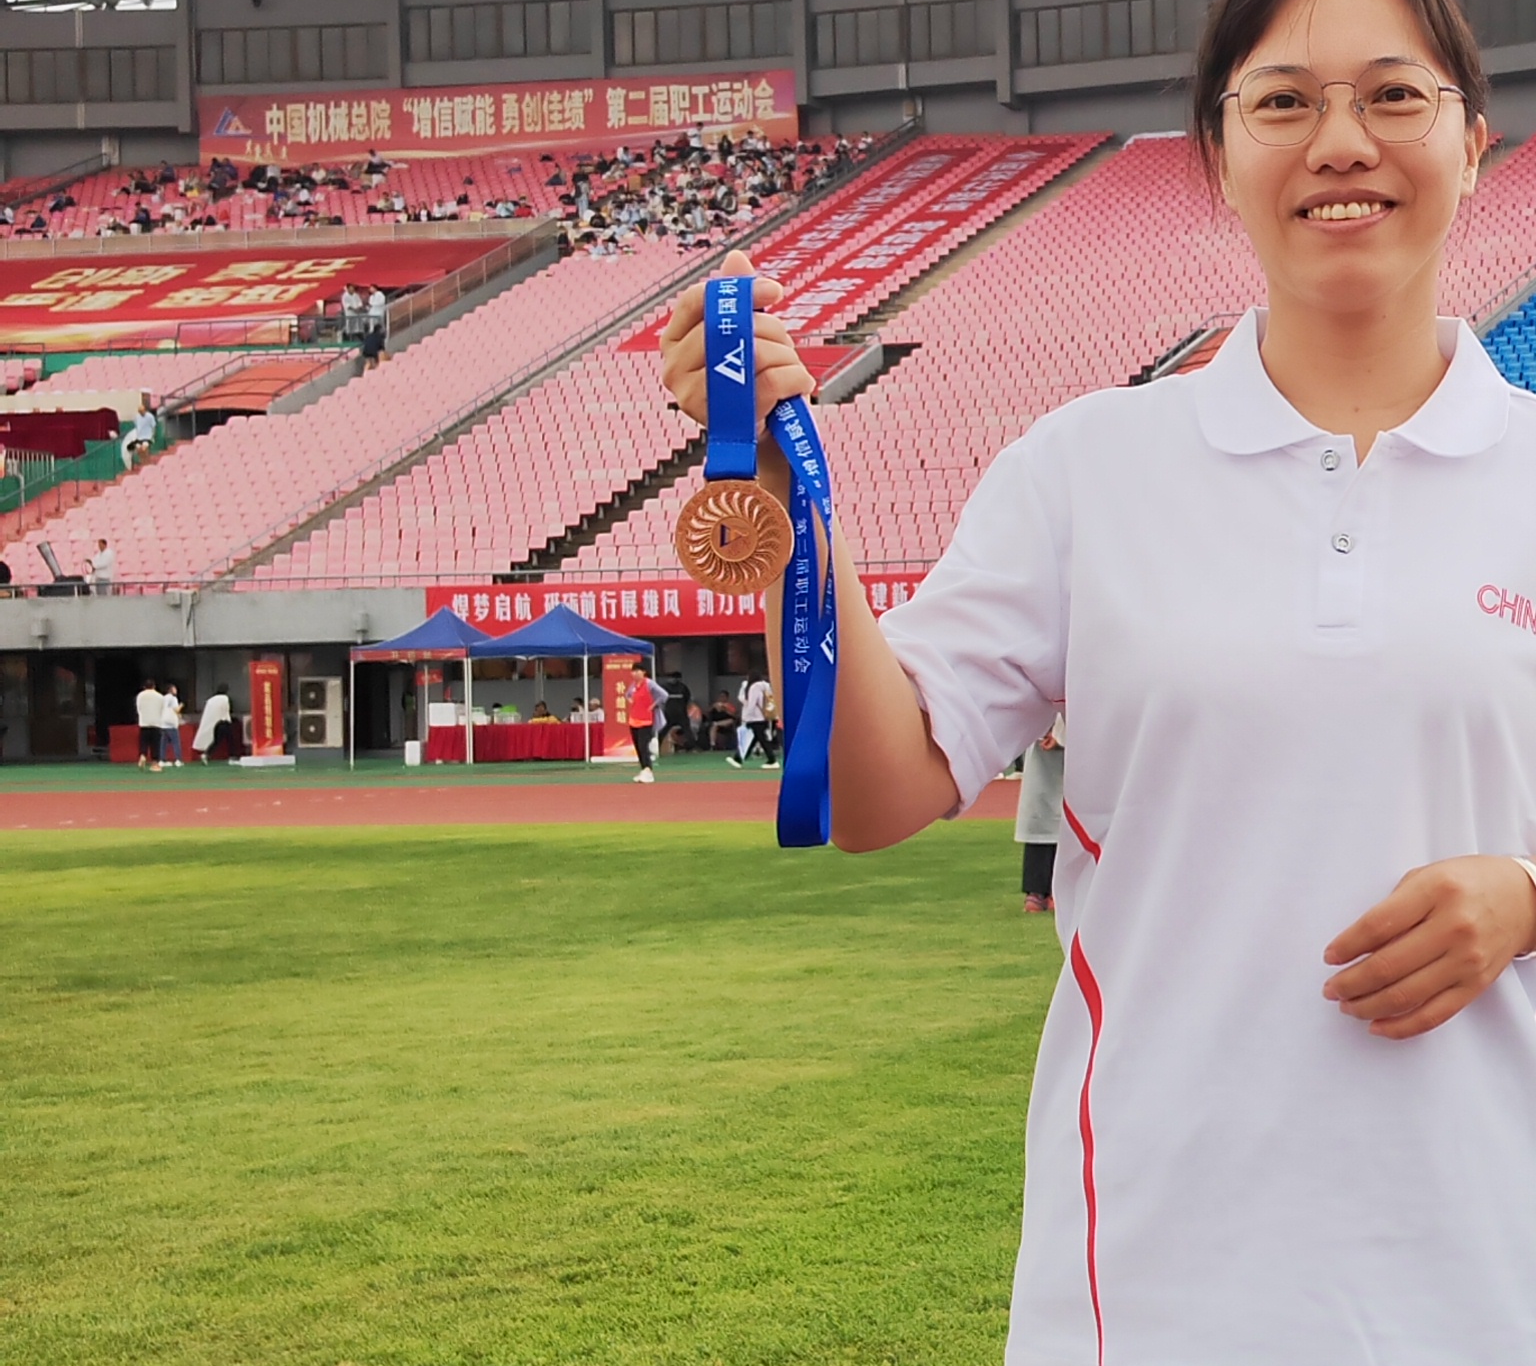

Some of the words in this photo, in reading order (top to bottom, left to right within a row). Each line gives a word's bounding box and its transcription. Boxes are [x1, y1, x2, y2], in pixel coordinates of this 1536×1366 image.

[264, 99, 392, 145] 中国机械总院
[605, 78, 776, 130] 第二届职工运动会
